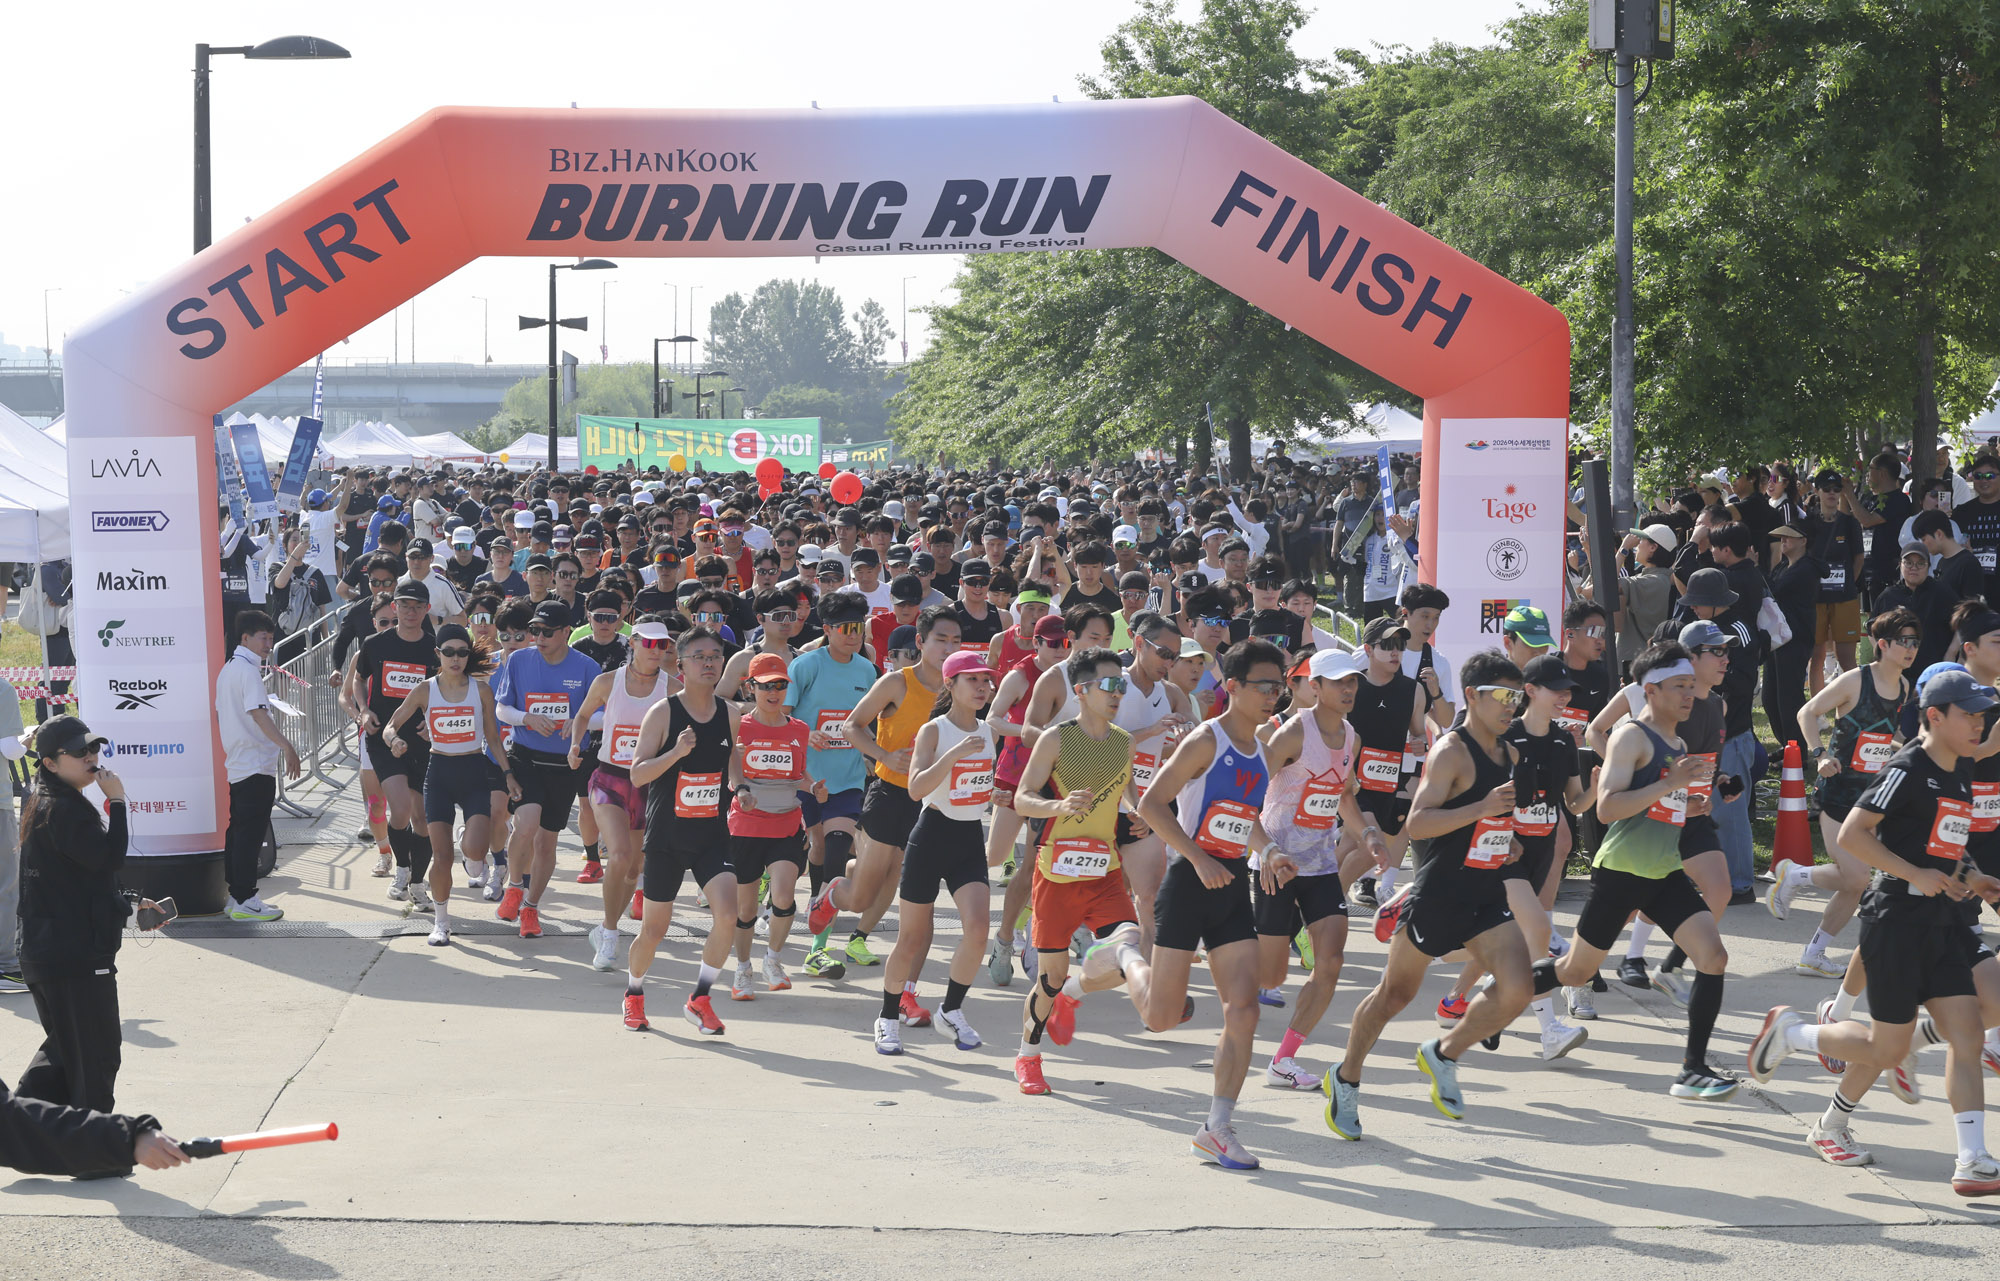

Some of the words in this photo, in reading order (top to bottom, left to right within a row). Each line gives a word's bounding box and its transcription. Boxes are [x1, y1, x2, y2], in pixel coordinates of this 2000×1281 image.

[526, 180, 908, 243] BURNING
[921, 174, 1113, 239] RUN
[815, 243, 891, 254] Casual
[898, 240, 992, 254] Running
[999, 237, 1086, 249] Festival
[1210, 170, 1473, 350] FINISH
[166, 178, 412, 360] START
[1482, 498, 1537, 525] Tage
[97, 515, 159, 530] FAVONEX
[1492, 540, 1524, 554] SUNBODY
[96, 567, 167, 591] Maxim
[1494, 569, 1521, 579] TANNING
[116, 636, 176, 647] NEWTREE
[398, 674, 424, 684] 2336
[109, 679, 168, 692] Reebok
[541, 705, 568, 714] 2163
[446, 719, 472, 728] 4451
[761, 754, 791, 764] 3802
[1132, 768, 1152, 780] 522
[1376, 764, 1398, 776] 2759
[685, 791, 694, 799] M
[129, 800, 188, 814] 롯데웰푸드
[1309, 799, 1318, 807] M
[1215, 820, 1225, 828] M
[1063, 856, 1072, 865] M
[1075, 855, 1108, 868] 2719
